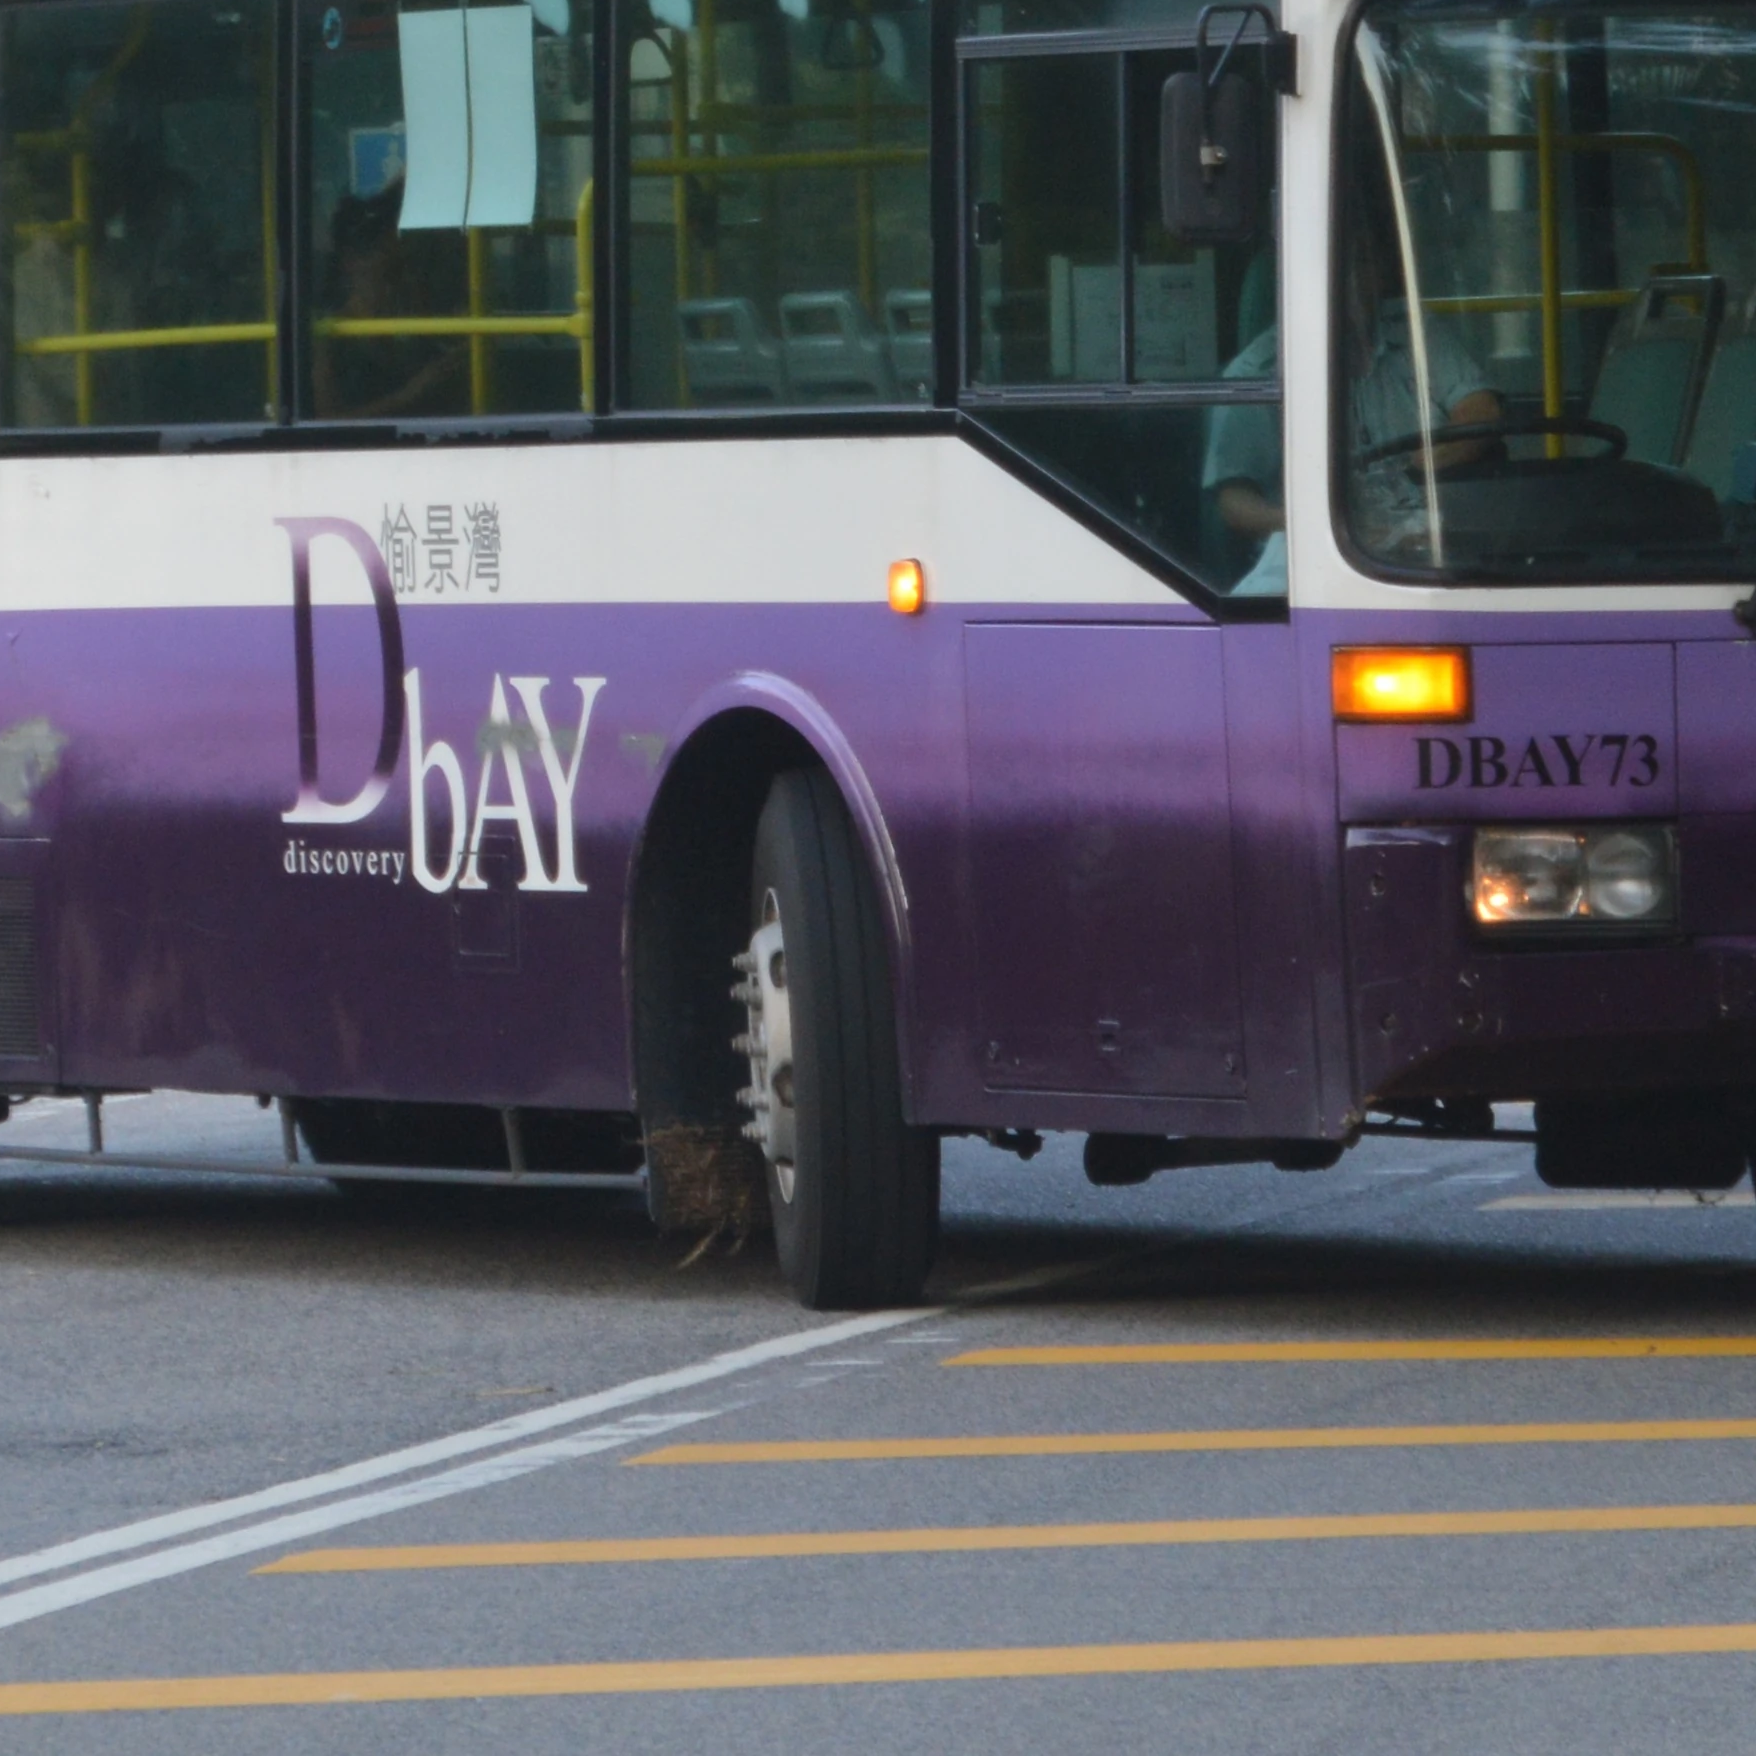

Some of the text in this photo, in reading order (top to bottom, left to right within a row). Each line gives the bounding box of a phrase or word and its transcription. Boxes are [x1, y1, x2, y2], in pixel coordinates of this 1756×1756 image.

[380, 501, 501, 594] 愉景灣
[1412, 733, 1660, 789] DBAY73
[283, 840, 406, 884] discovery
